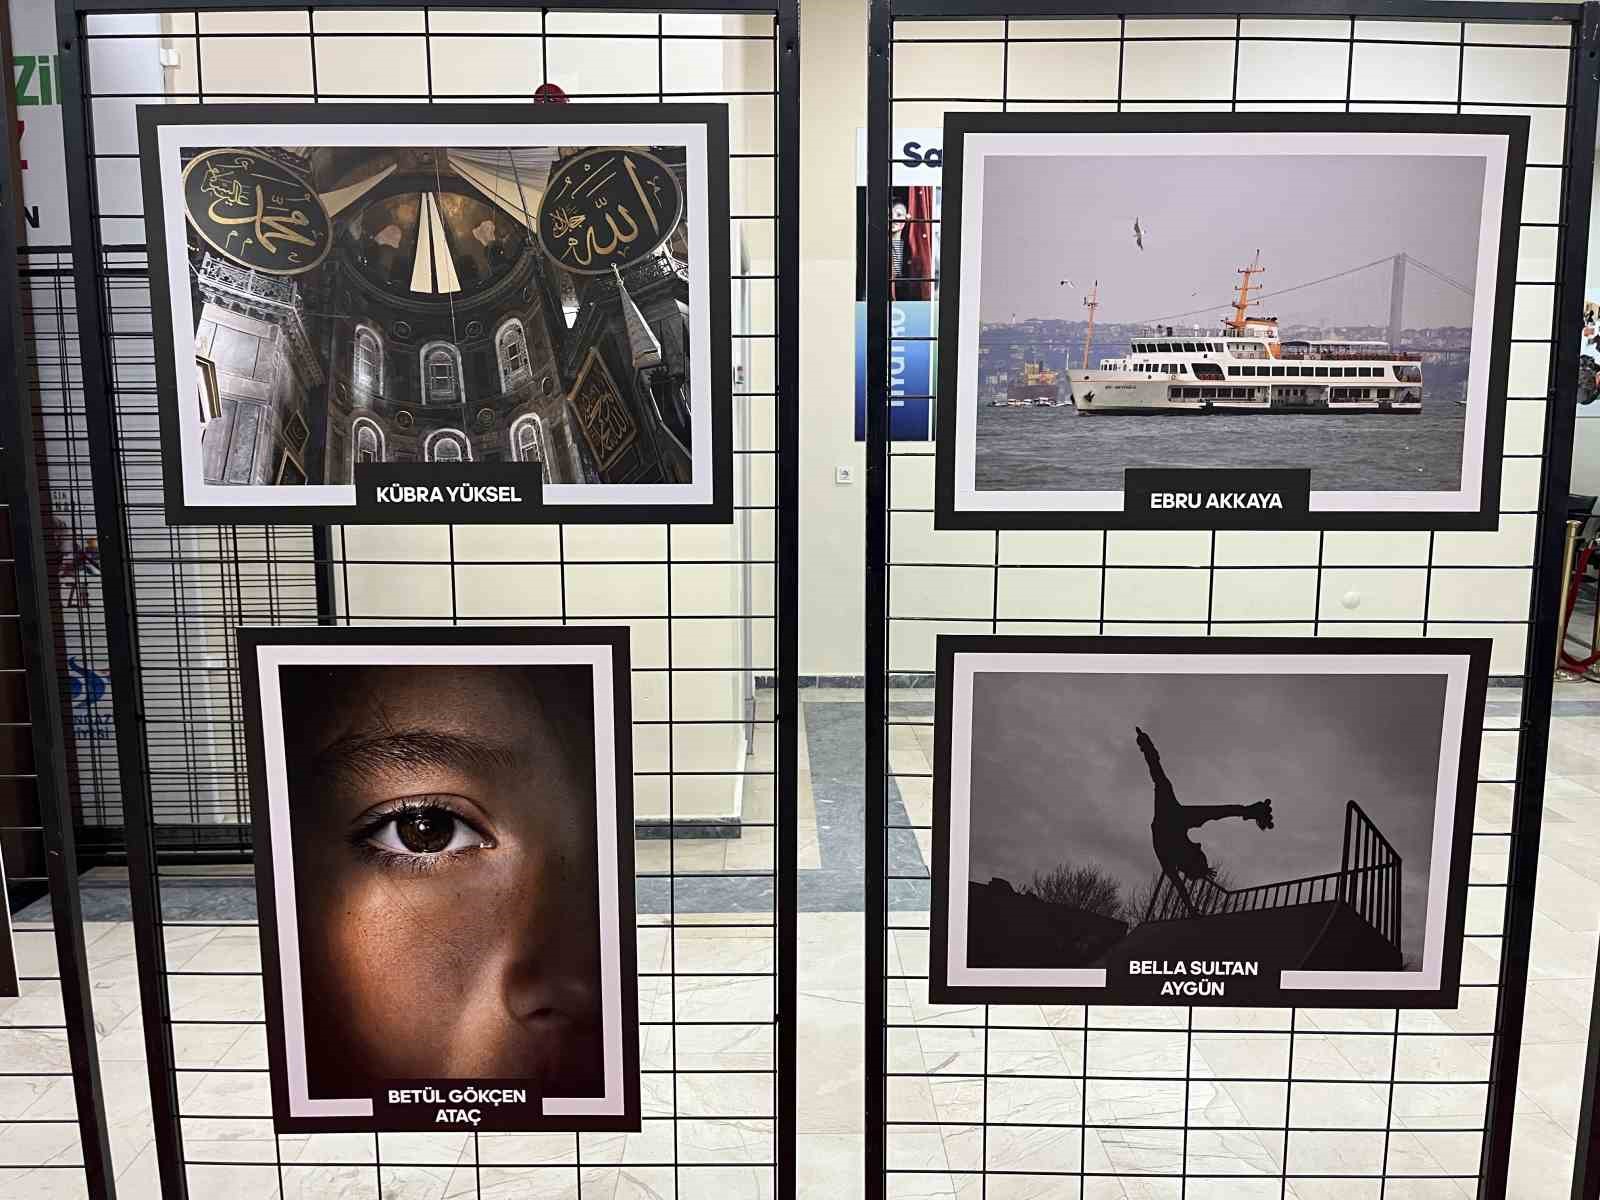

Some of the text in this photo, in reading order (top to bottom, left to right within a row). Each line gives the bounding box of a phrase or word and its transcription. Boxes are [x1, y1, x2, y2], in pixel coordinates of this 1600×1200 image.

[376, 483, 522, 503] KÜBRA YÜKSEL
[1150, 492, 1283, 509] EBRU AKKAYA
[1129, 960, 1259, 976] BELLA SULTAN
[1160, 978, 1225, 996] AYGÜN
[388, 1086, 527, 1107] BETÜL GÖKÇEN
[435, 1108, 482, 1126] ATAÇ
